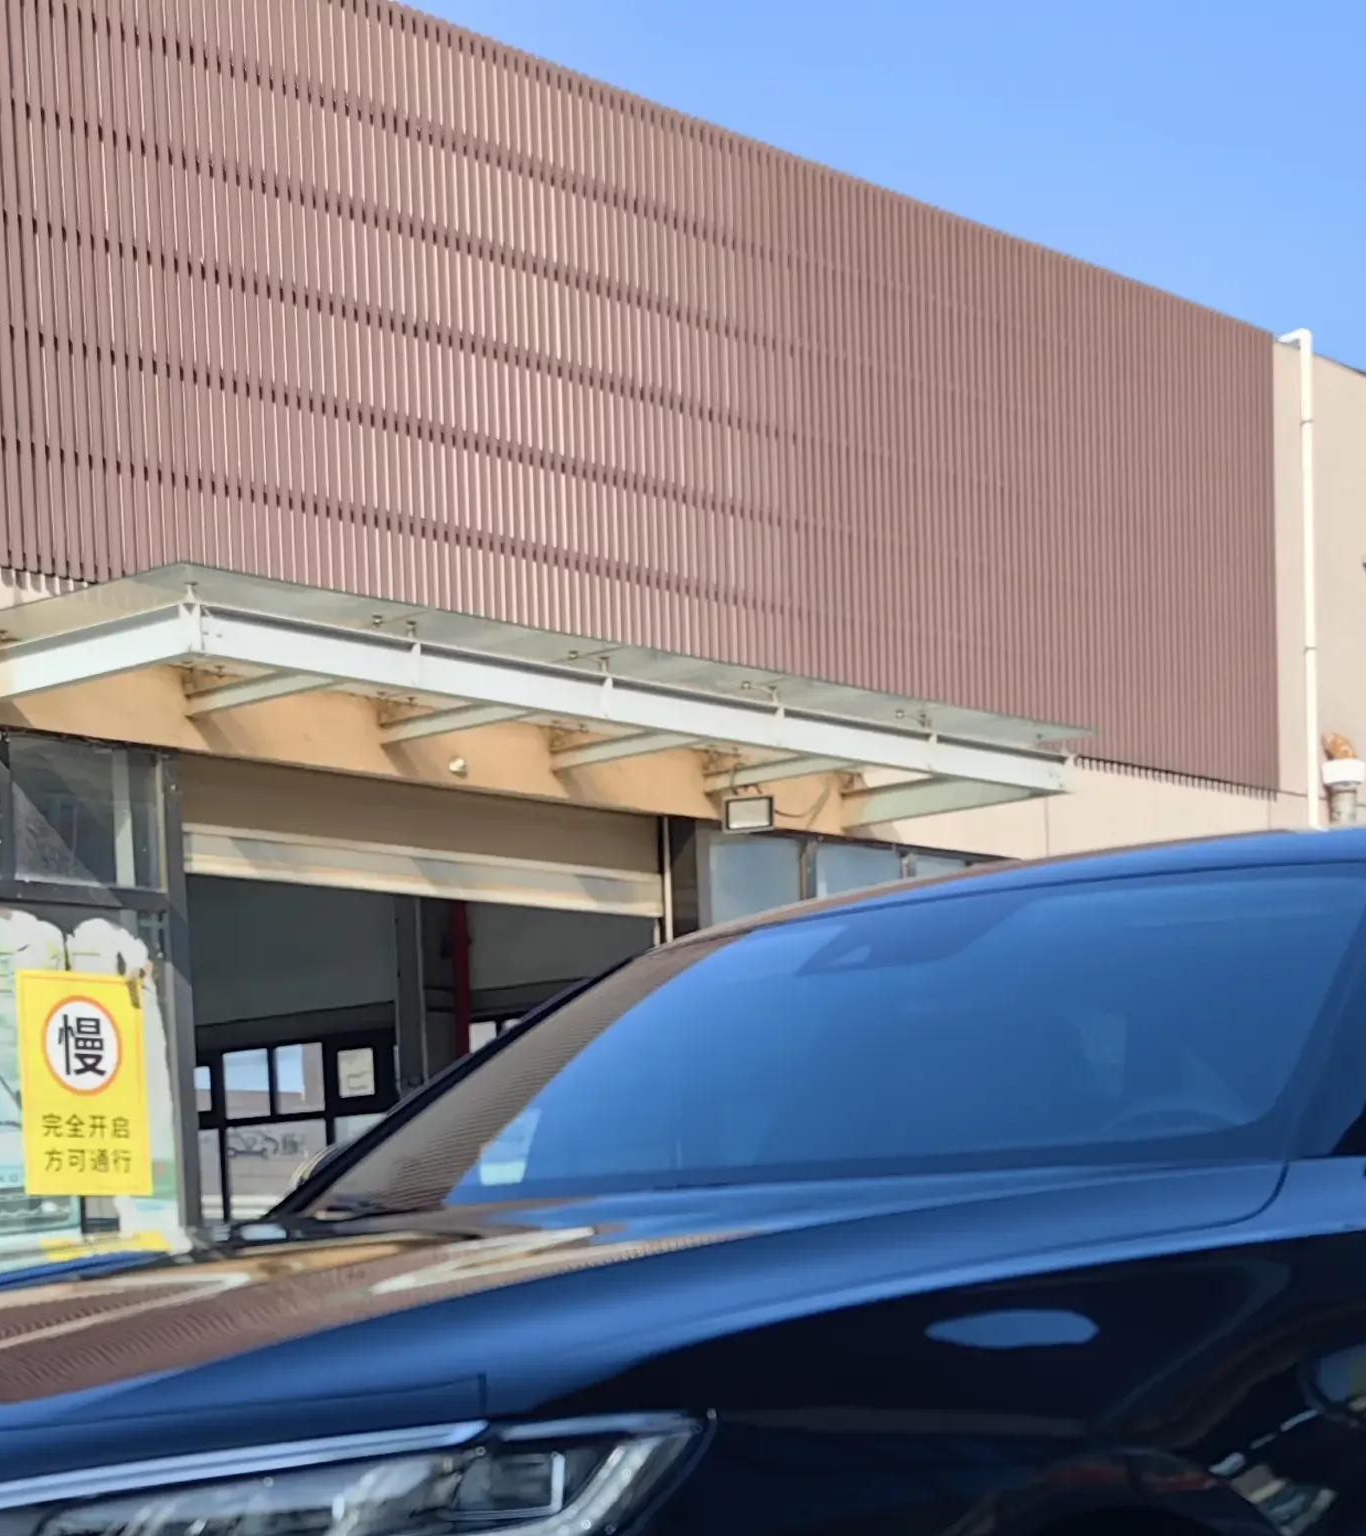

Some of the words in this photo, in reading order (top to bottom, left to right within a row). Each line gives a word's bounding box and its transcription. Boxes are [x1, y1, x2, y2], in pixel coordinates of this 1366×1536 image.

[56, 1013, 109, 1077] 慢
[41, 1115, 132, 1141] 完全开启
[43, 1148, 133, 1173] 方可通行
